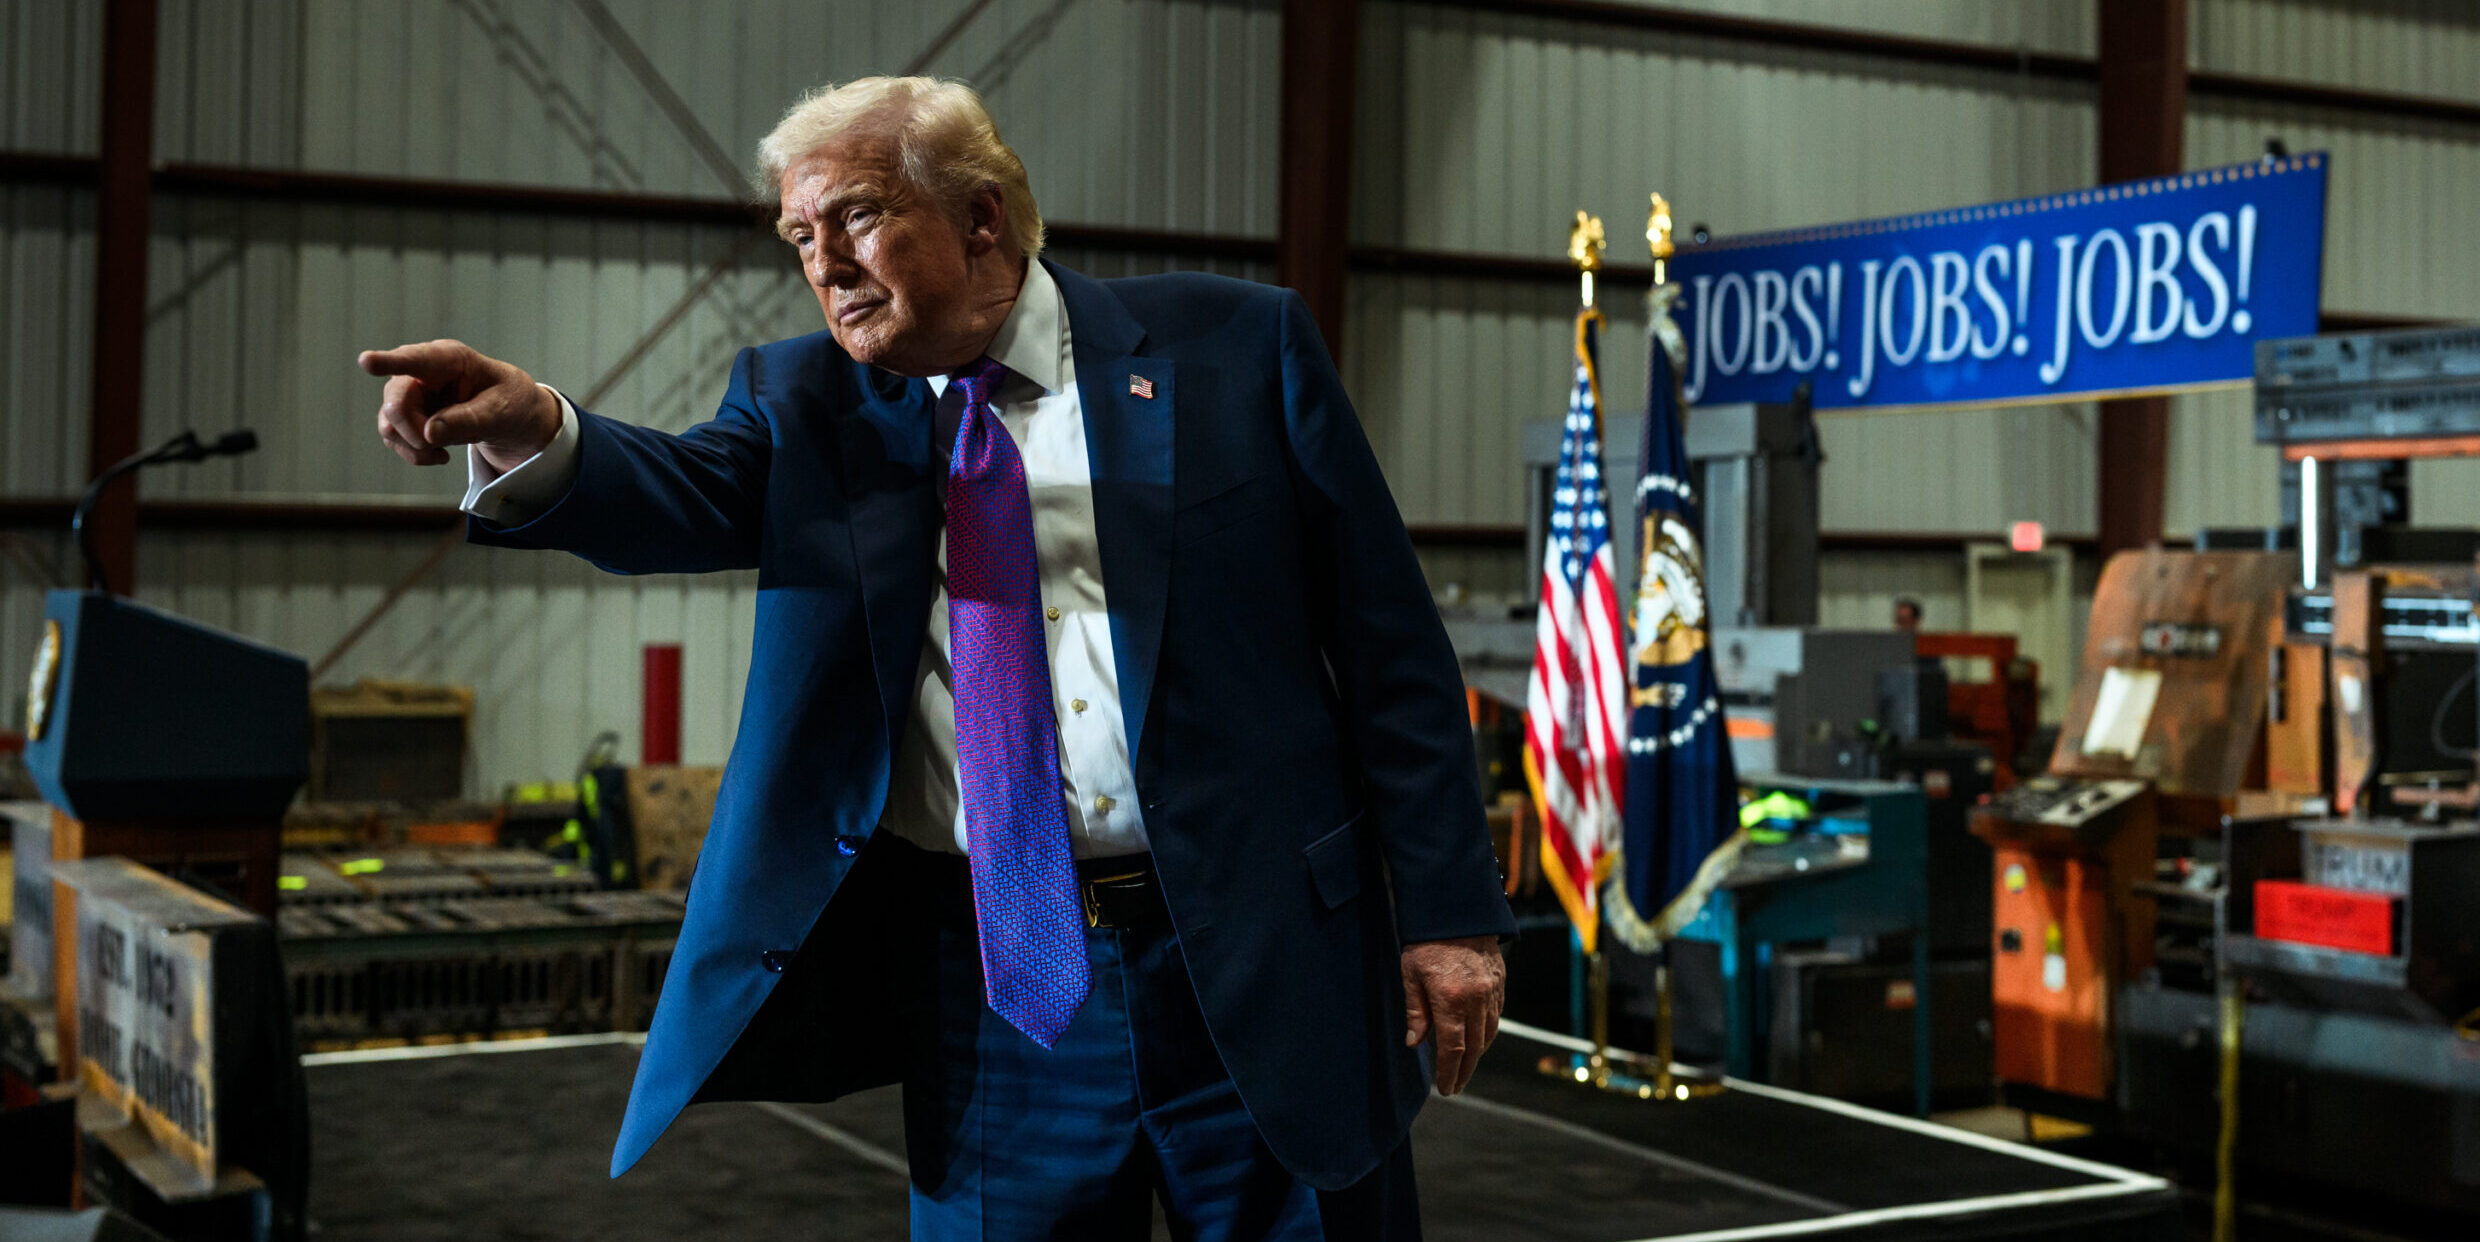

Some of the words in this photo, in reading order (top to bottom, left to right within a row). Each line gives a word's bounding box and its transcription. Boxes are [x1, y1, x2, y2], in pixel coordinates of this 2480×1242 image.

[1684, 261, 1842, 402] JOBS!
[1849, 238, 2033, 397] JOBS!
[2039, 203, 2257, 385] JOBS!
